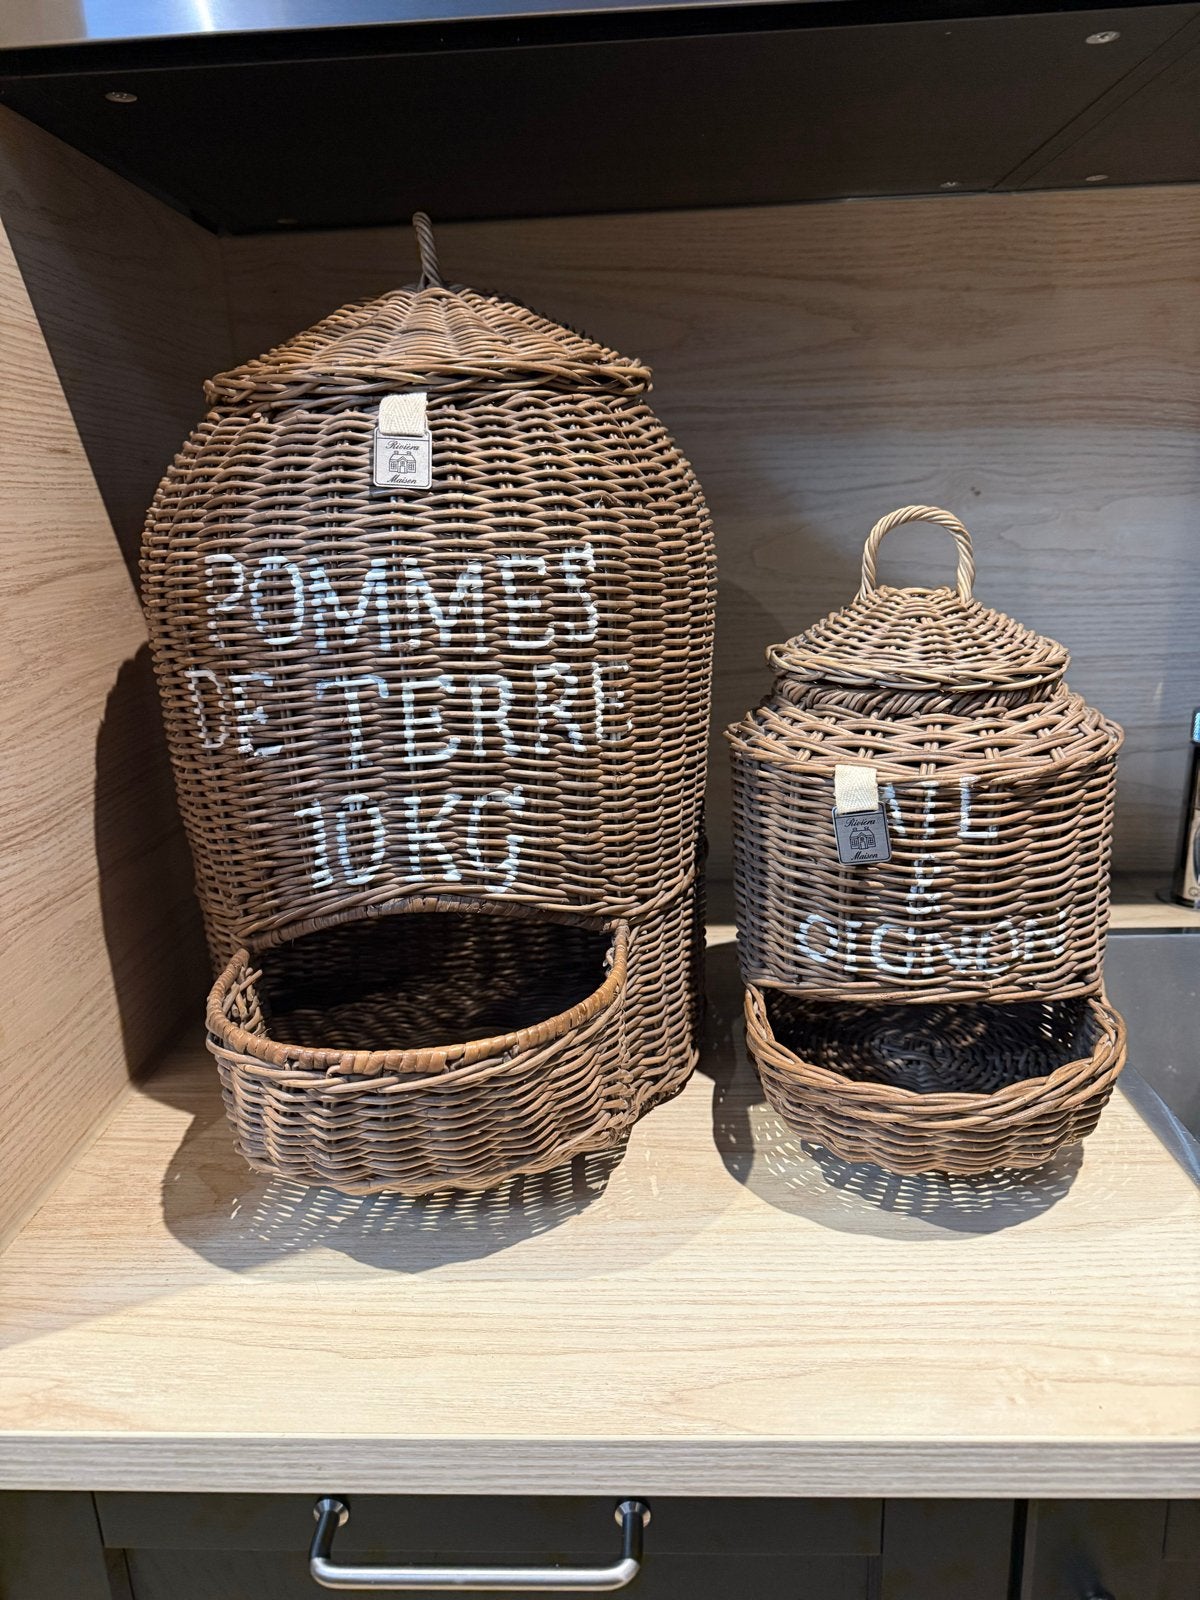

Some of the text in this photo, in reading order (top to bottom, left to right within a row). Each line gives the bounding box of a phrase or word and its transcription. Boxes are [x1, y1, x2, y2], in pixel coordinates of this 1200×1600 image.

[387, 474, 417, 484] Maison
[205, 544, 598, 654] POMMES
[186, 662, 634, 770] DE TERRE
[851, 851, 879, 861] Maison
